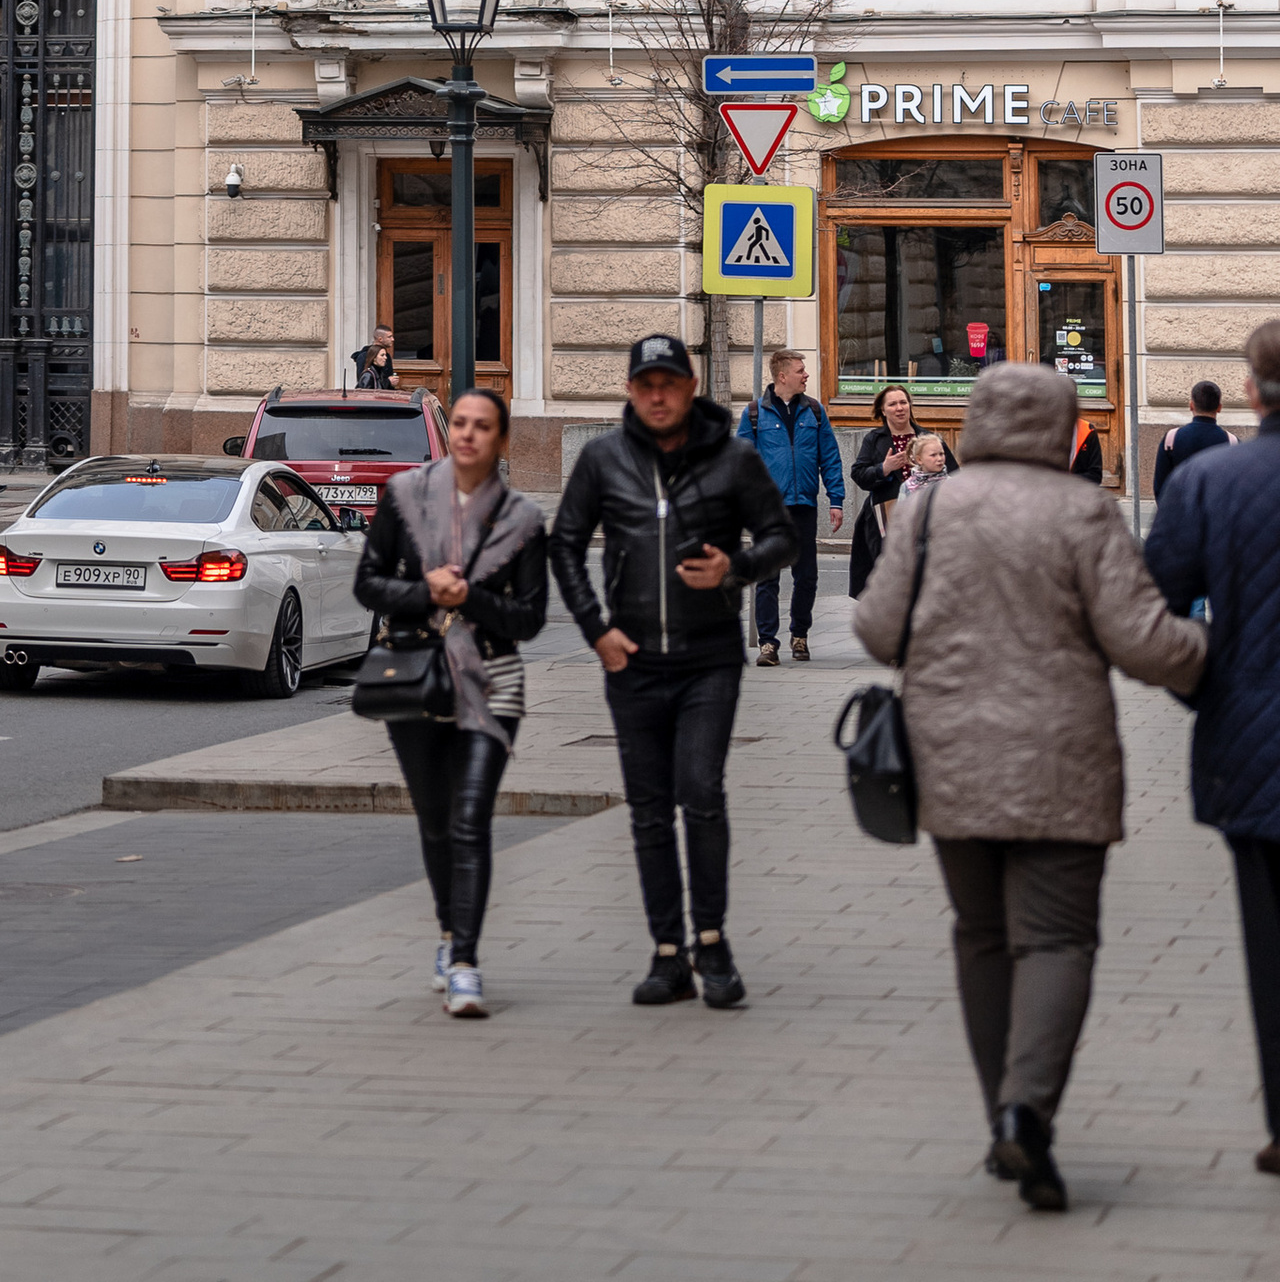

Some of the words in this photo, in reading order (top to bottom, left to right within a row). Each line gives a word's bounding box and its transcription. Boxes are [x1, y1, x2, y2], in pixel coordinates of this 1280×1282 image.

[861, 83, 1029, 124] PRIME
[1039, 100, 1118, 125] CAFE
[1110, 159, 1147, 171] ЗОНА
[1116, 196, 1143, 215] 50
[331, 474, 351, 483] Jeep
[125, 568, 140, 580] 90
